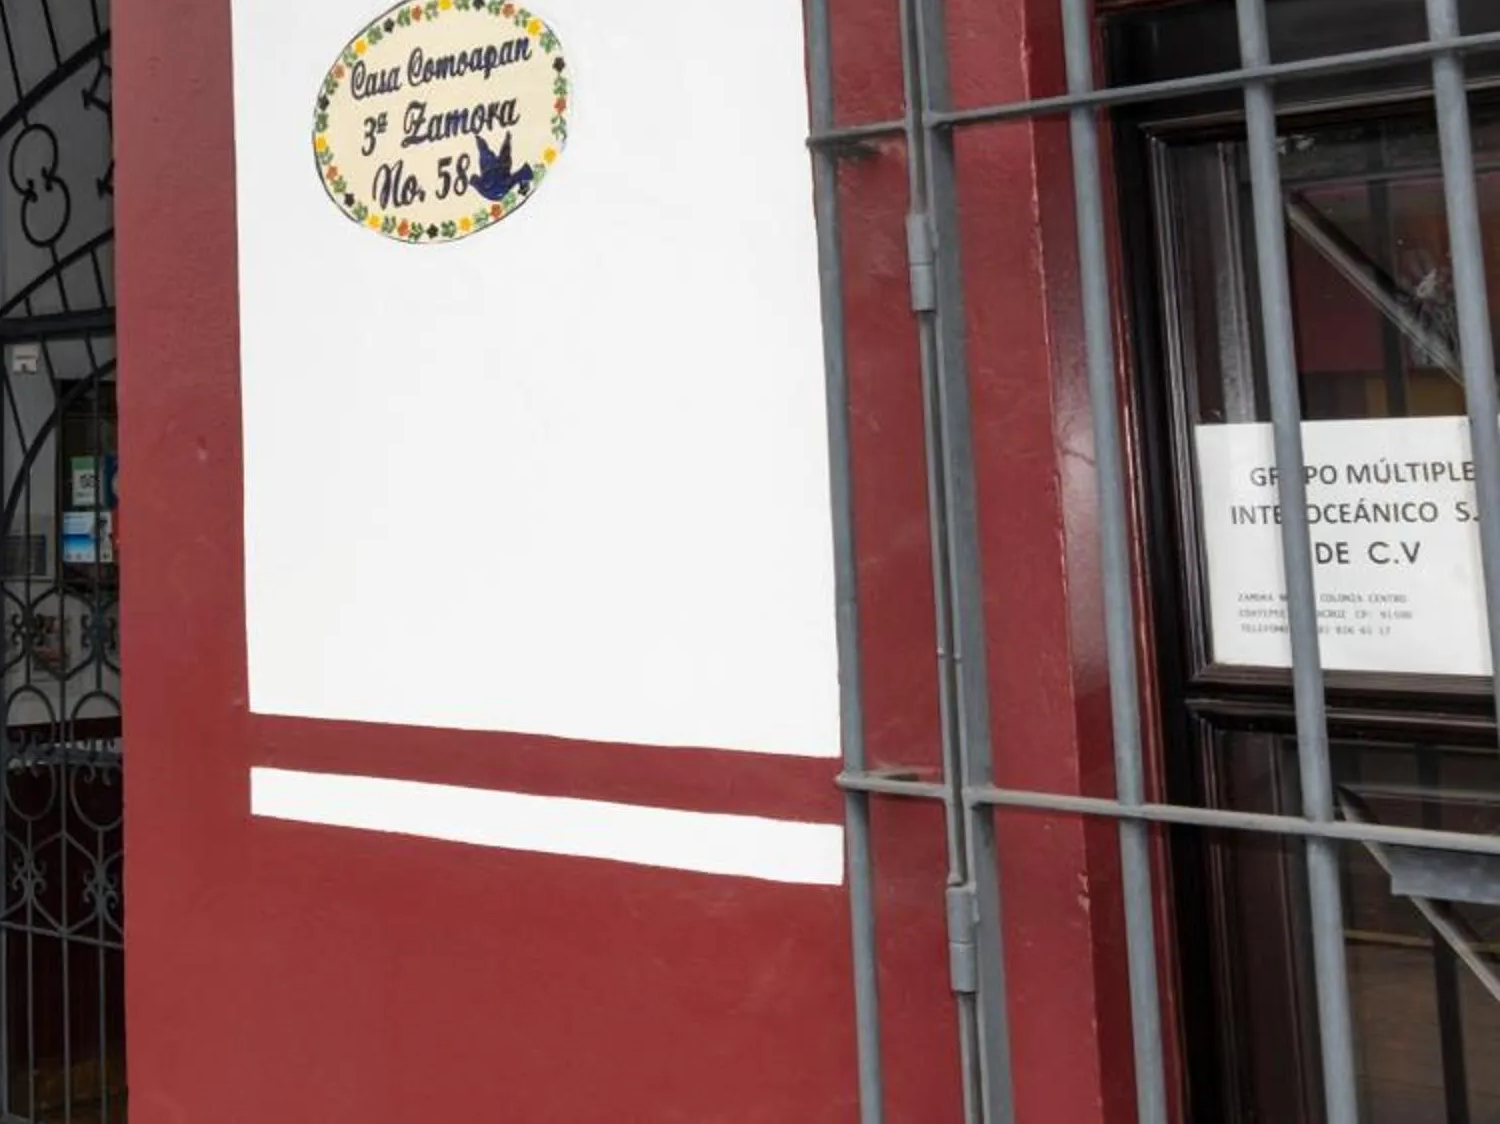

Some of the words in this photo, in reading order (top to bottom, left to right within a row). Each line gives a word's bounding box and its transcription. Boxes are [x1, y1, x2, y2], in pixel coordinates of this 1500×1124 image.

[350, 59, 401, 101] Casa
[407, 35, 532, 87] Comoapan
[401, 97, 520, 148] Zamora
[372, 159, 425, 210] No.
[435, 153, 471, 199] 58
[1250, 464, 1338, 487] GRPO
[1346, 458, 1477, 484] MÚLTIPLE
[1230, 498, 1439, 525] INTEOCEÁNICO
[1315, 541, 1350, 565] DE
[1367, 541, 1421, 565] C.V
